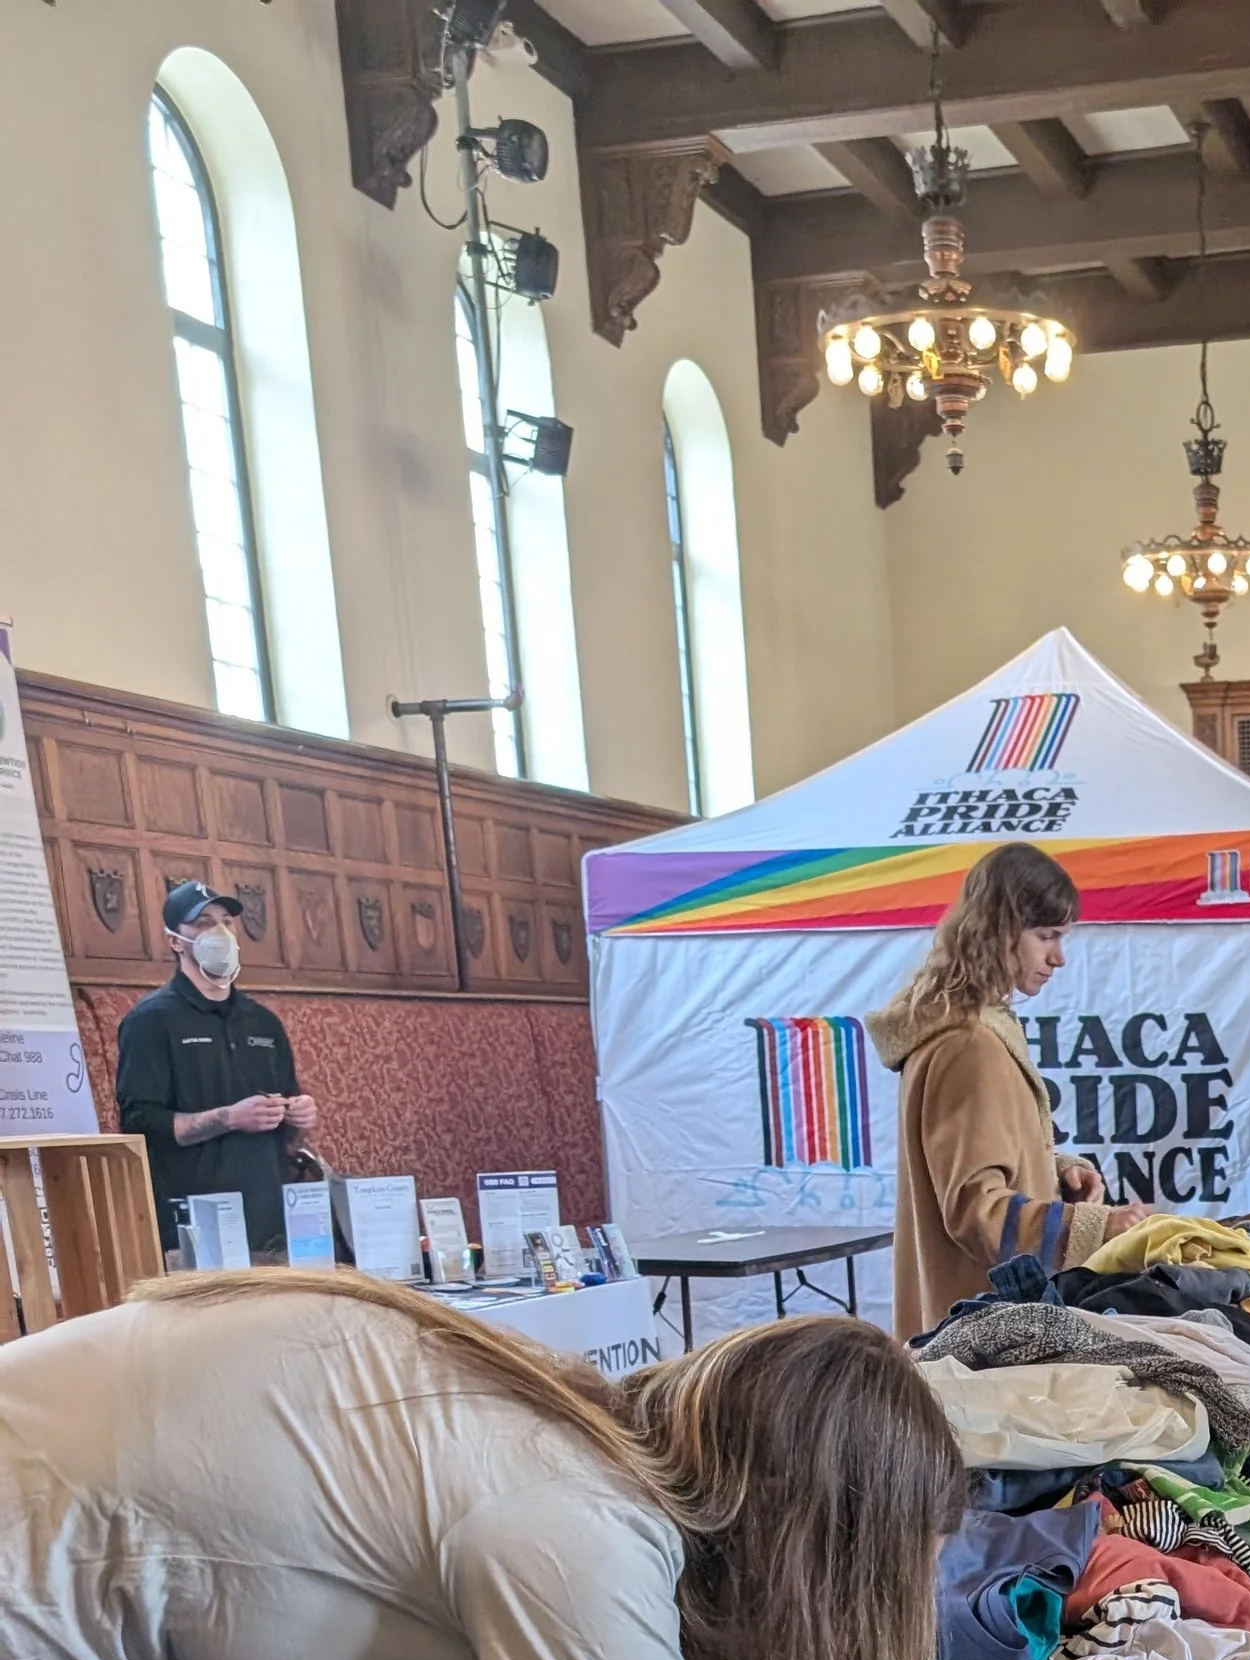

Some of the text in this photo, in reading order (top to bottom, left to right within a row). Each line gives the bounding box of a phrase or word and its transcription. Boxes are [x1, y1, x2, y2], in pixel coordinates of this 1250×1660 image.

[913, 787, 1079, 806] ITHACA
[900, 801, 1076, 823] PRIDE
[889, 818, 1066, 838] ALLIANCE
[24, 1051, 43, 1064] 988
[27, 1088, 48, 1101] Line
